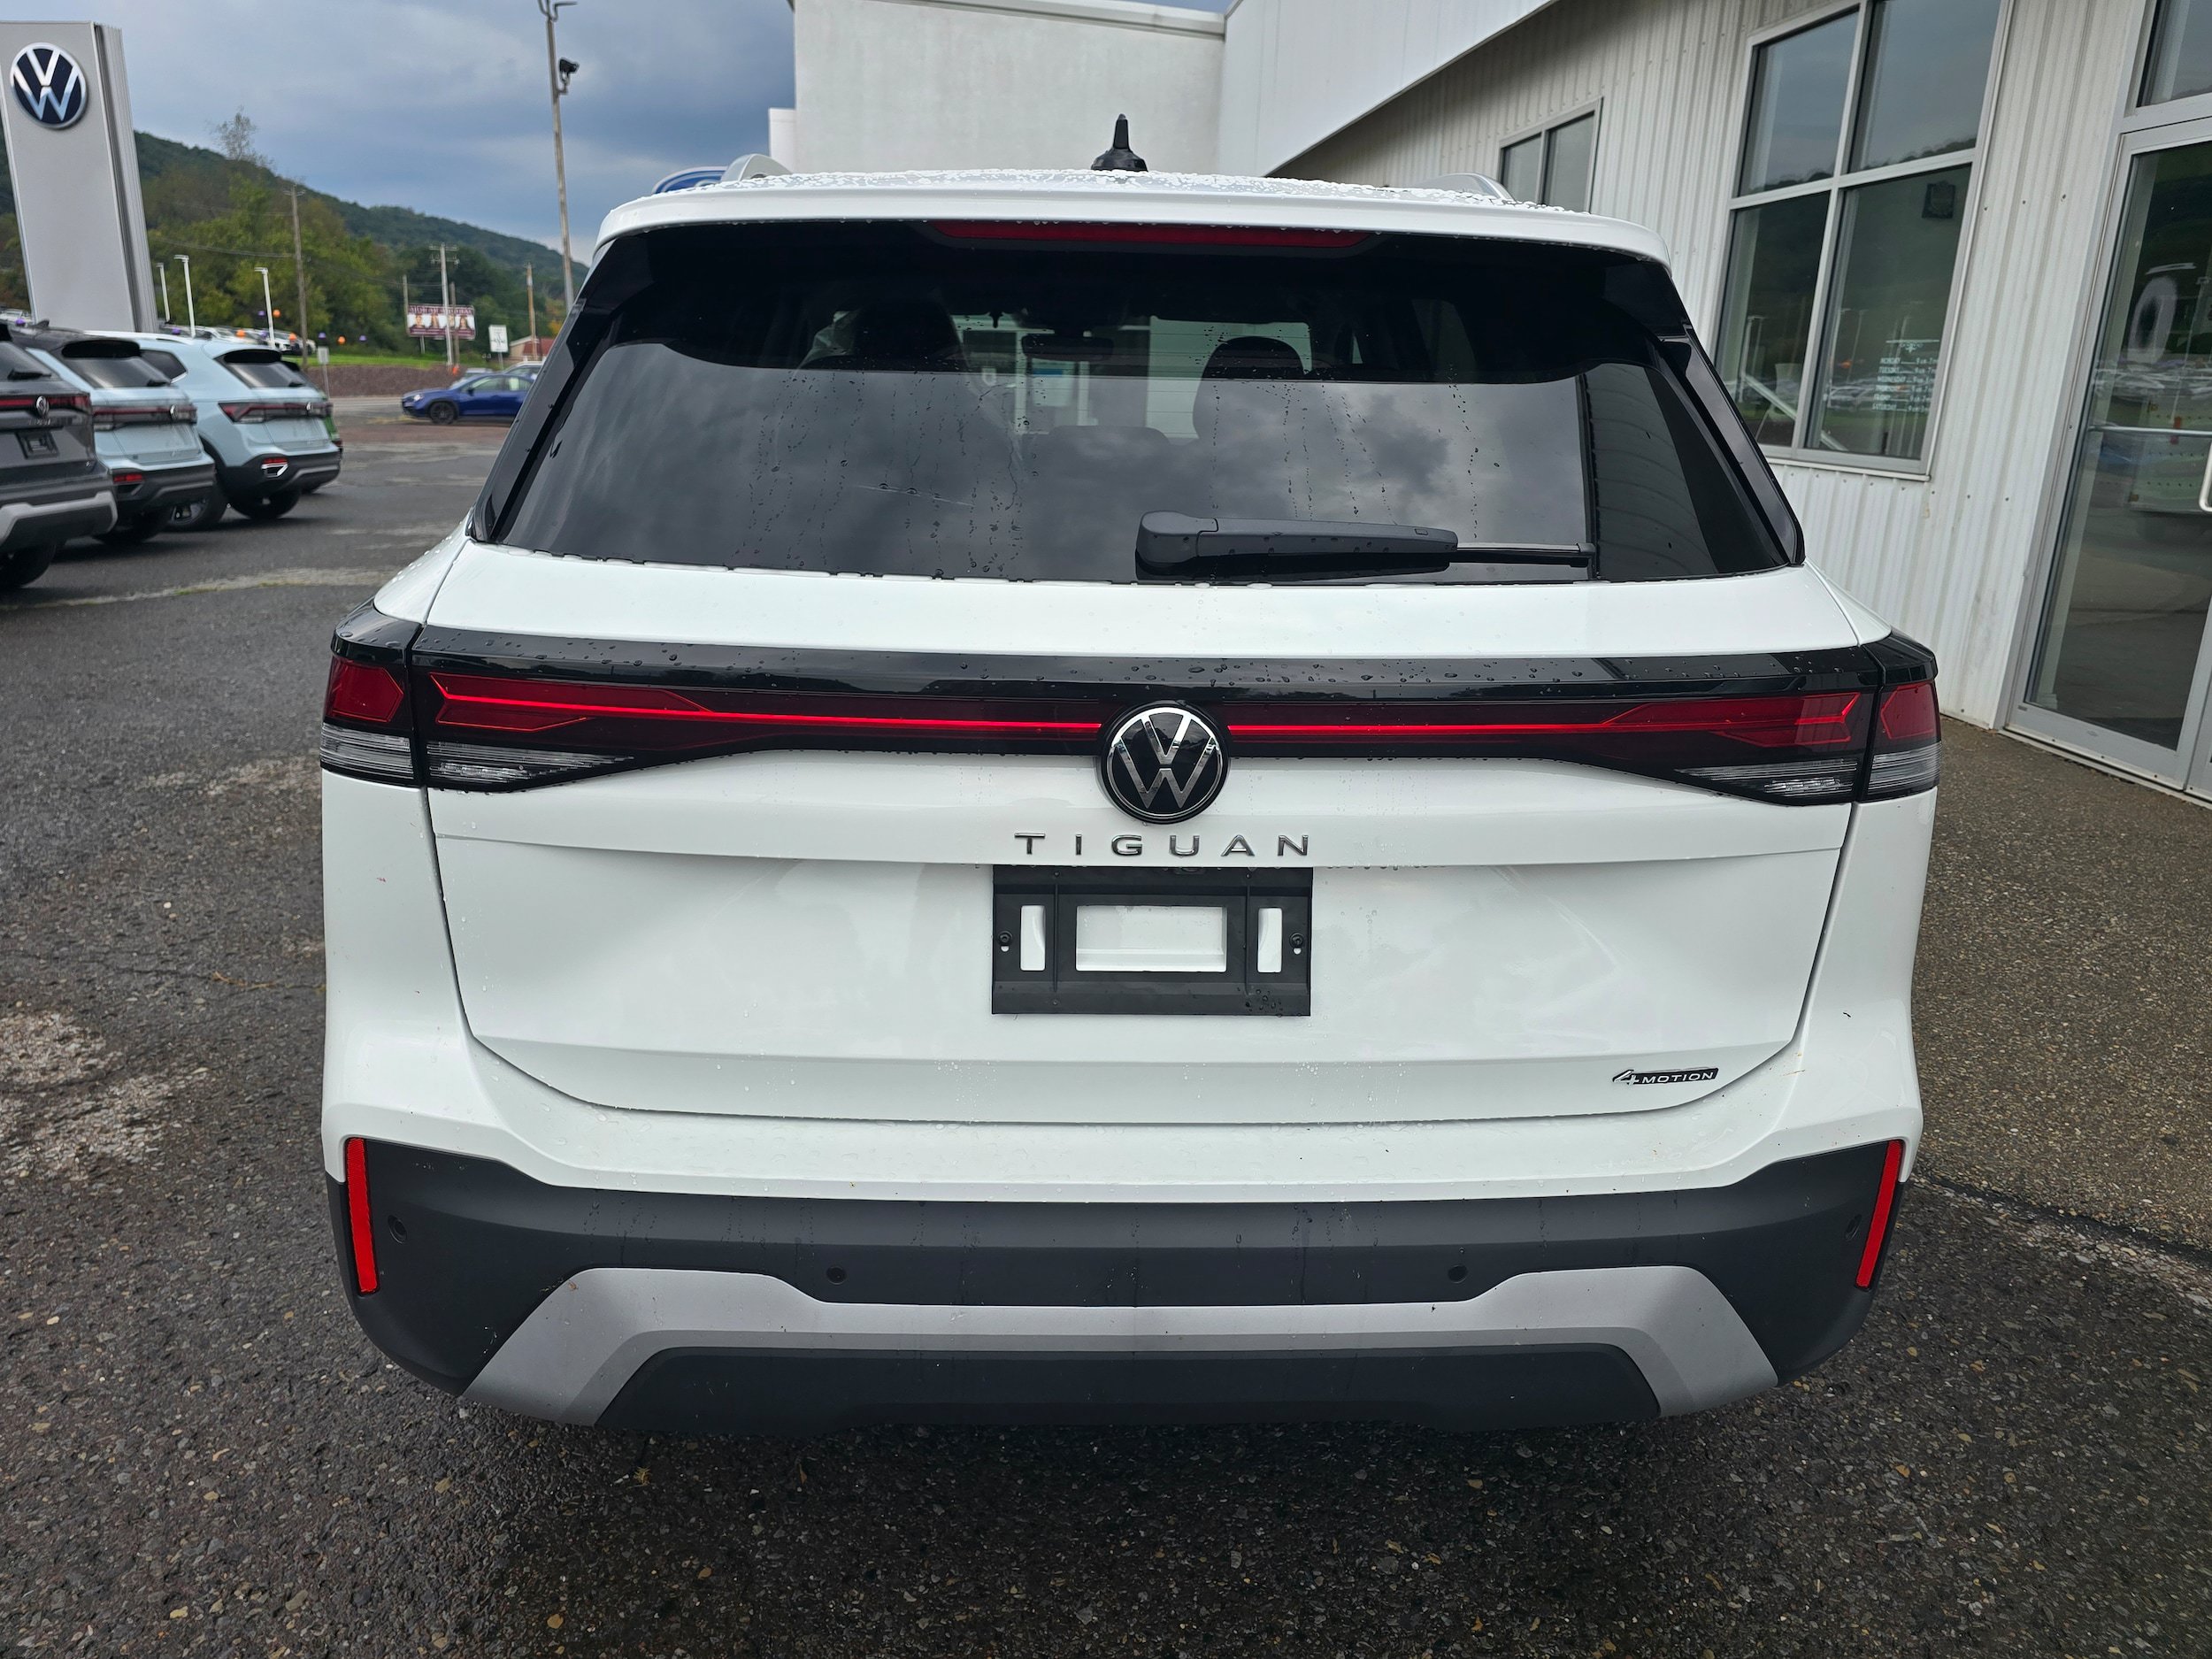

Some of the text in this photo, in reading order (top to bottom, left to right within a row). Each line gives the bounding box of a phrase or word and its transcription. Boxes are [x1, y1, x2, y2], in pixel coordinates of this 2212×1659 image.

[1110, 710, 1221, 812] VW
[1014, 833, 1309, 857] TIGUAN
[1613, 1069, 1717, 1086] 4MOTION
